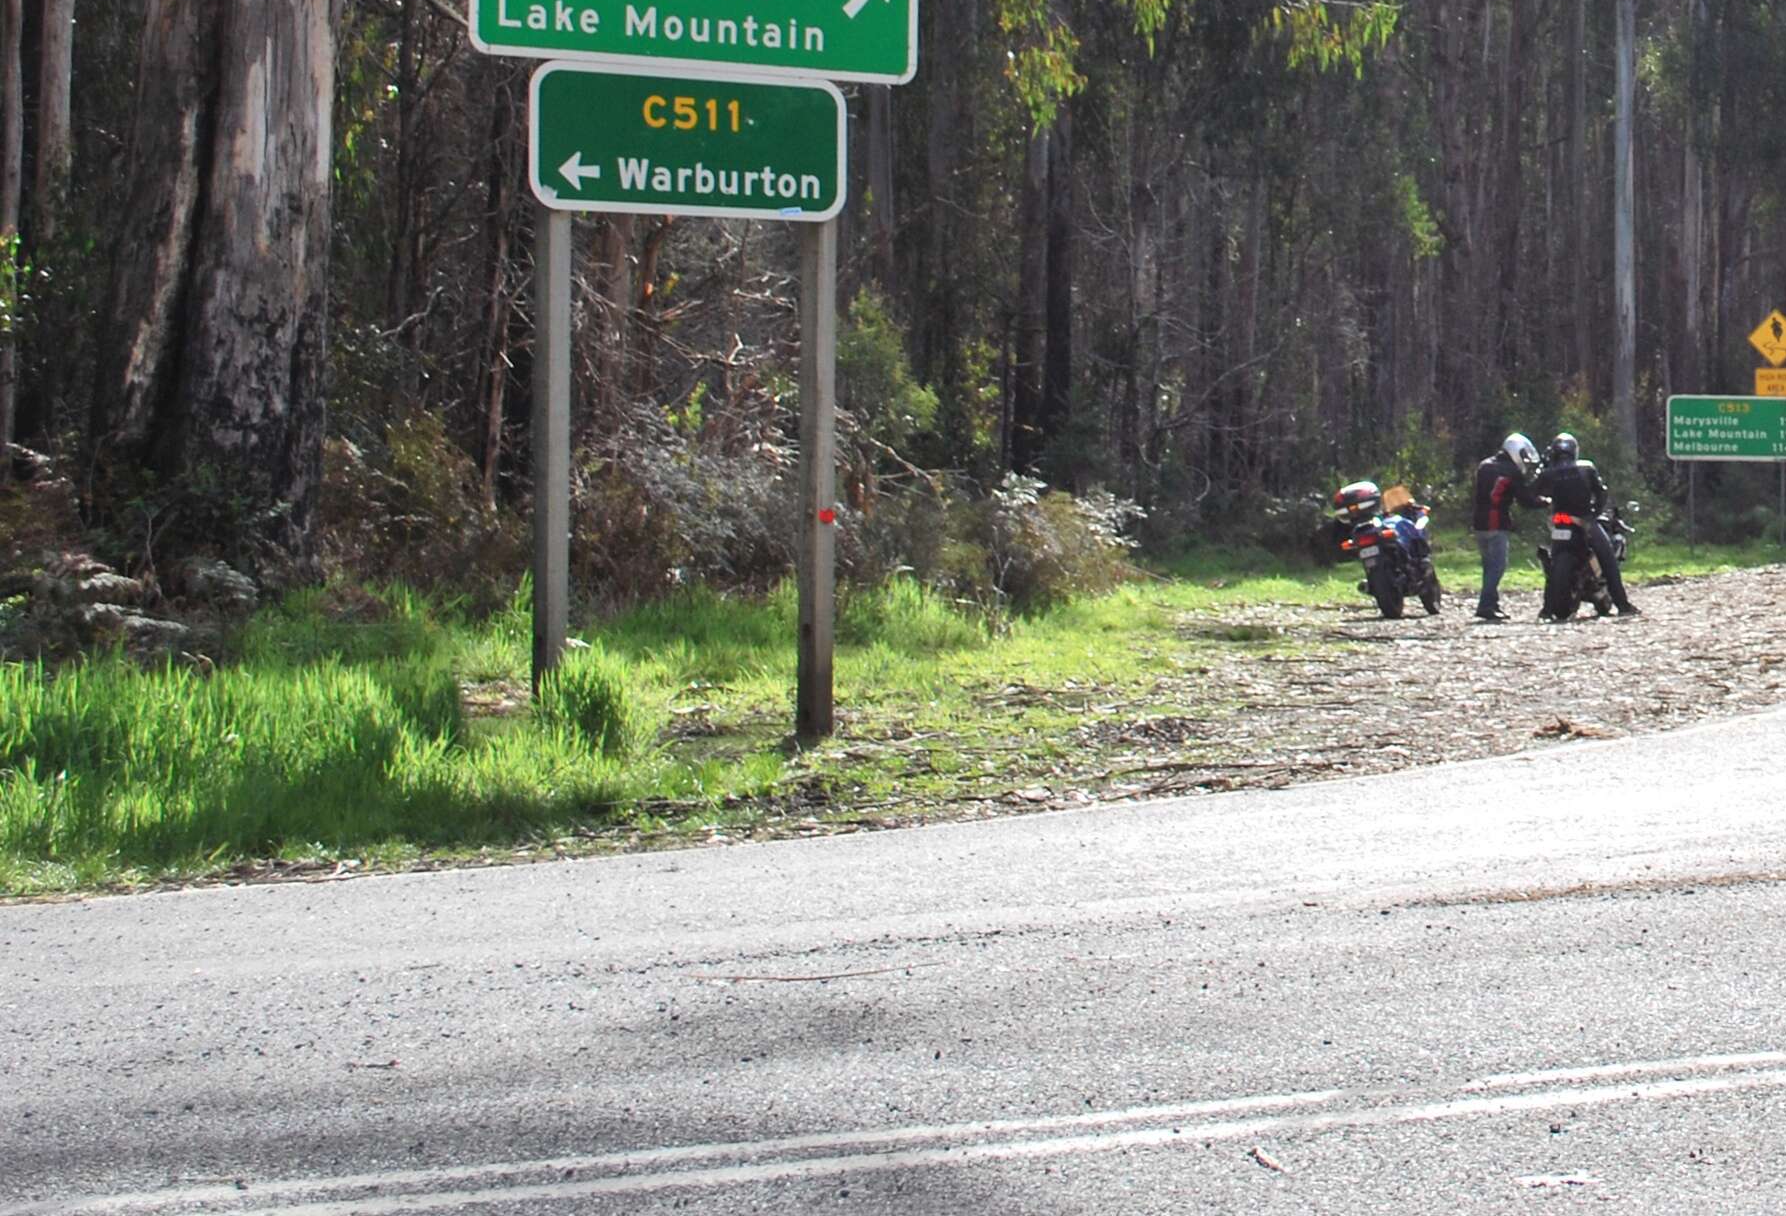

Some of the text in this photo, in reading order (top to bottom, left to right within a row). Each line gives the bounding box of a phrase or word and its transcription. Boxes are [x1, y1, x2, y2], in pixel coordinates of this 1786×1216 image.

[624, 4, 825, 52] Mountain
[642, 95, 741, 133] C511
[617, 156, 822, 200] Warburton
[1718, 402, 1750, 413] C513
[1673, 416, 1739, 427] Marysville
[1673, 429, 1703, 439] Lake
[1708, 429, 1768, 440] Mountain
[1673, 442, 1739, 452] Melbourne
